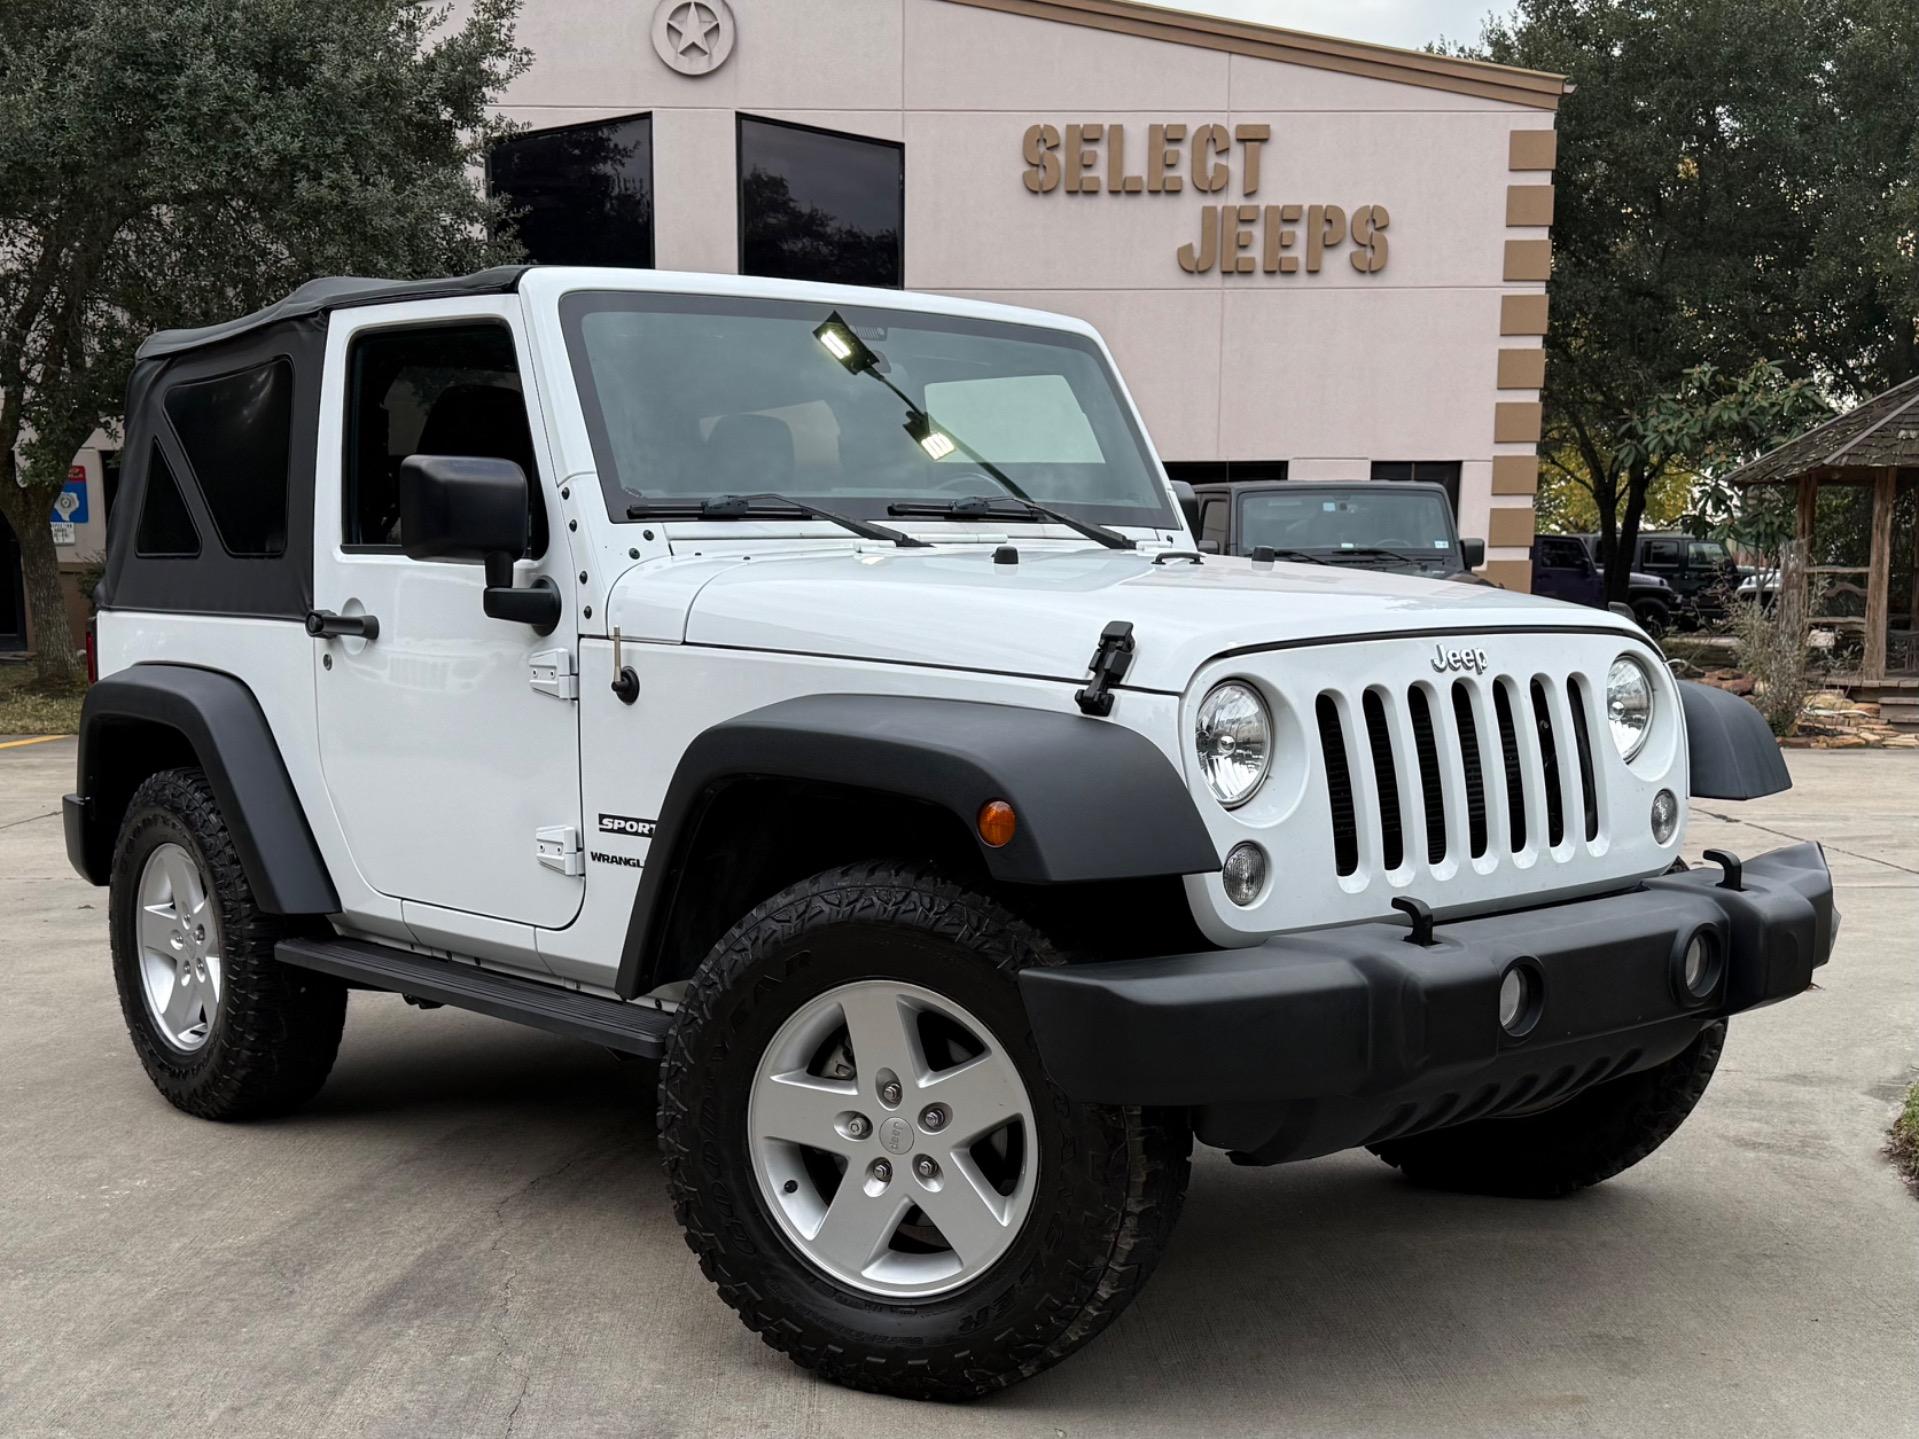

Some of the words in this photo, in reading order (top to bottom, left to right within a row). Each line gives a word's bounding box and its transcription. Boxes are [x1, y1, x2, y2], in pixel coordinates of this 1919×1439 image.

[1022, 123, 1271, 197] SELECT
[1176, 204, 1391, 275] JEEPS
[1430, 642, 1488, 675] Jeep
